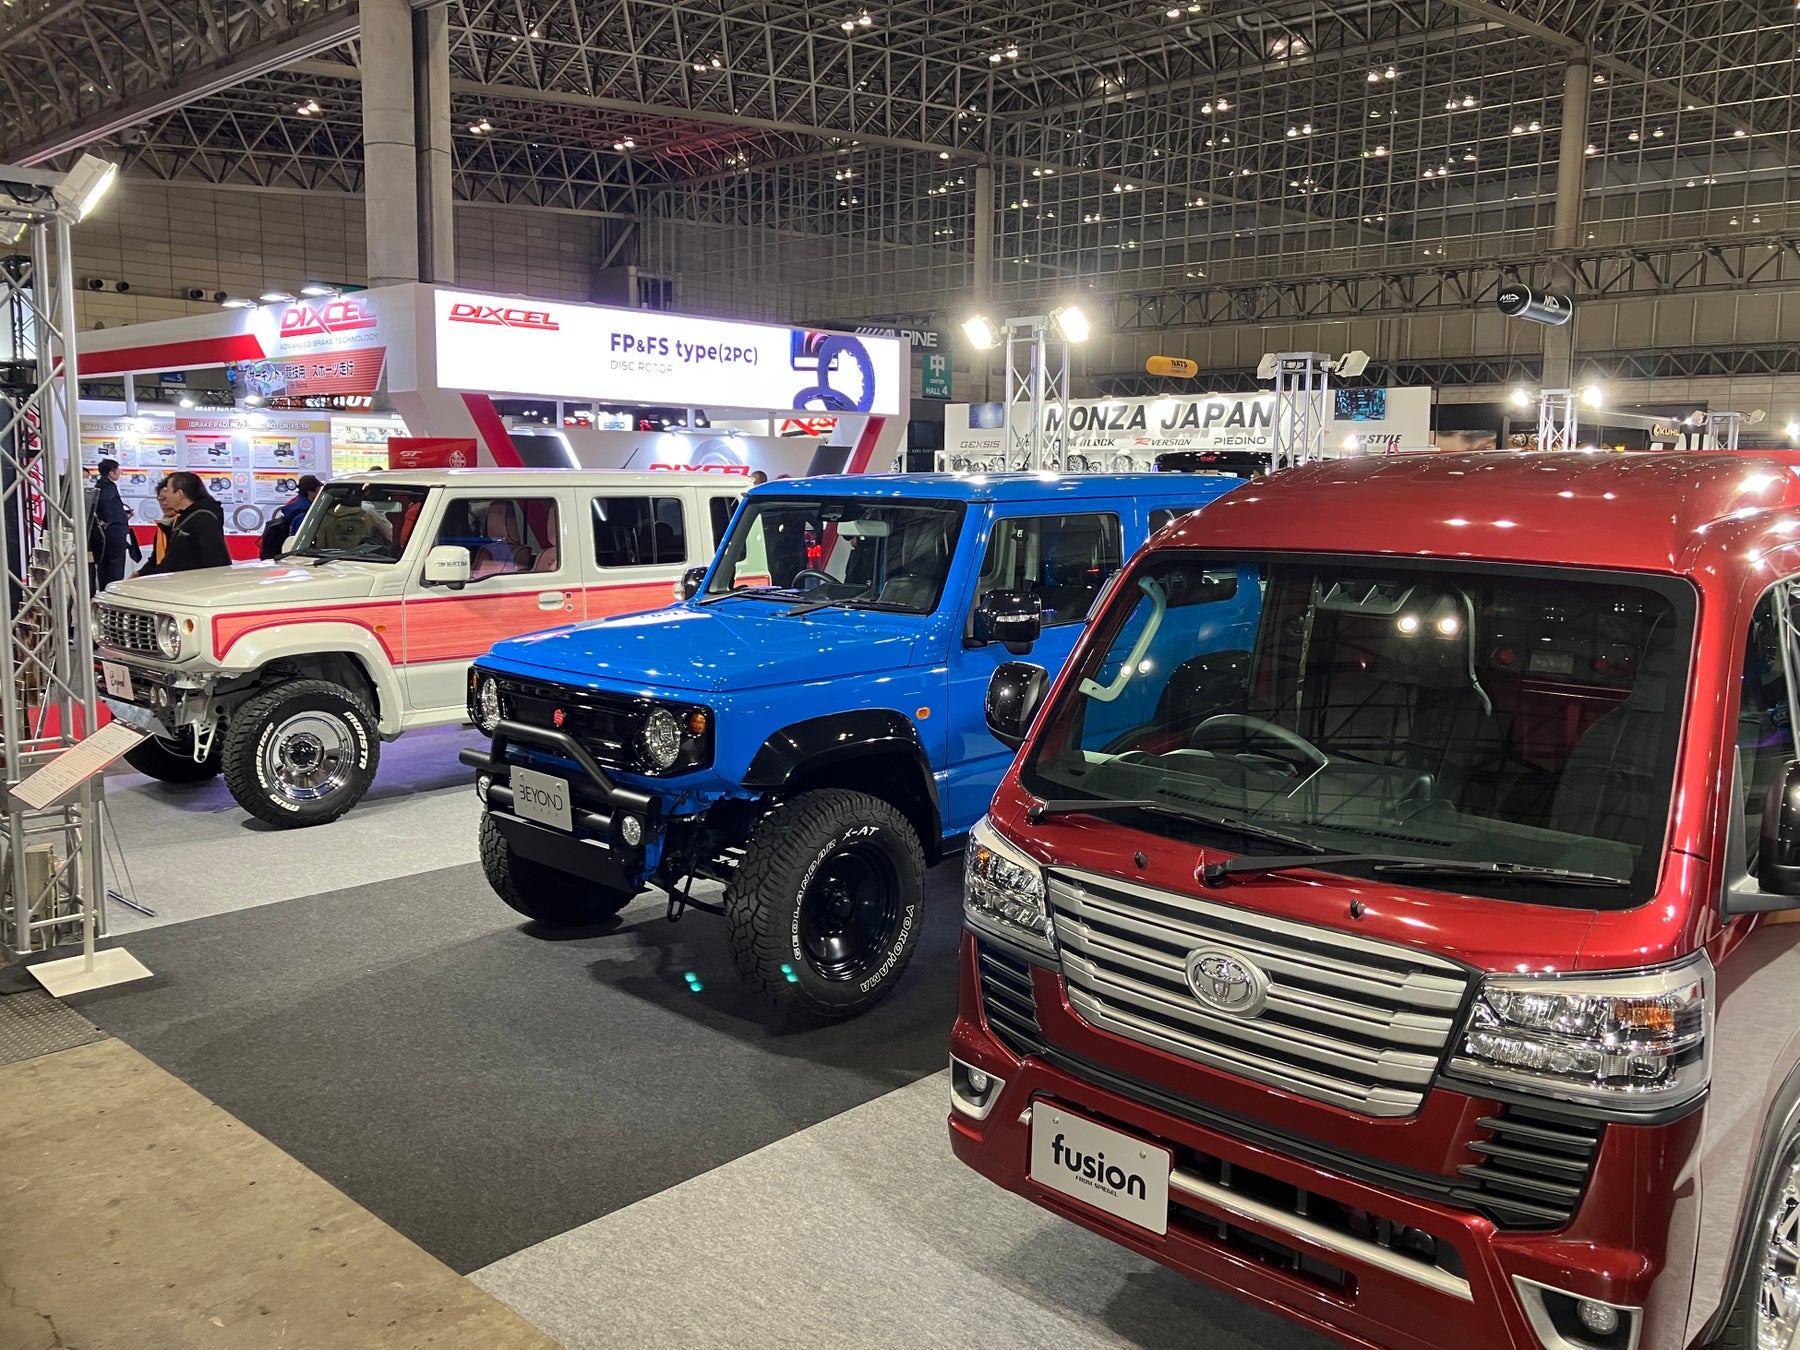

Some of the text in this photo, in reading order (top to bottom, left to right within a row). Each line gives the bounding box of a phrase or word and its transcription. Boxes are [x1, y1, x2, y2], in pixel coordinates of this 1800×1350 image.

[280, 298, 378, 335] DIXCEL
[449, 303, 559, 328] DIXCEL
[313, 338, 333, 347] BRAKE
[610, 332, 758, 366] FP&FS type(2PC)
[610, 360, 635, 371] DISC
[930, 353, 945, 377] 中
[926, 385, 948, 396] HALL 4
[1045, 401, 1276, 432] MONZA JAPAN
[960, 440, 1000, 448] GEXSIS
[1151, 438, 1191, 446] VERSION
[1213, 436, 1266, 445] PIEDINO
[1367, 434, 1402, 444] STYLE
[343, 711, 369, 770] MONSTA
[255, 722, 300, 812] MUD WARRIOR
[519, 784, 563, 811] BEYOND
[791, 825, 880, 961] GEOLANDAR X-AT
[860, 904, 915, 992] YOKOHAMA
[1051, 1133, 1146, 1201] fusion
